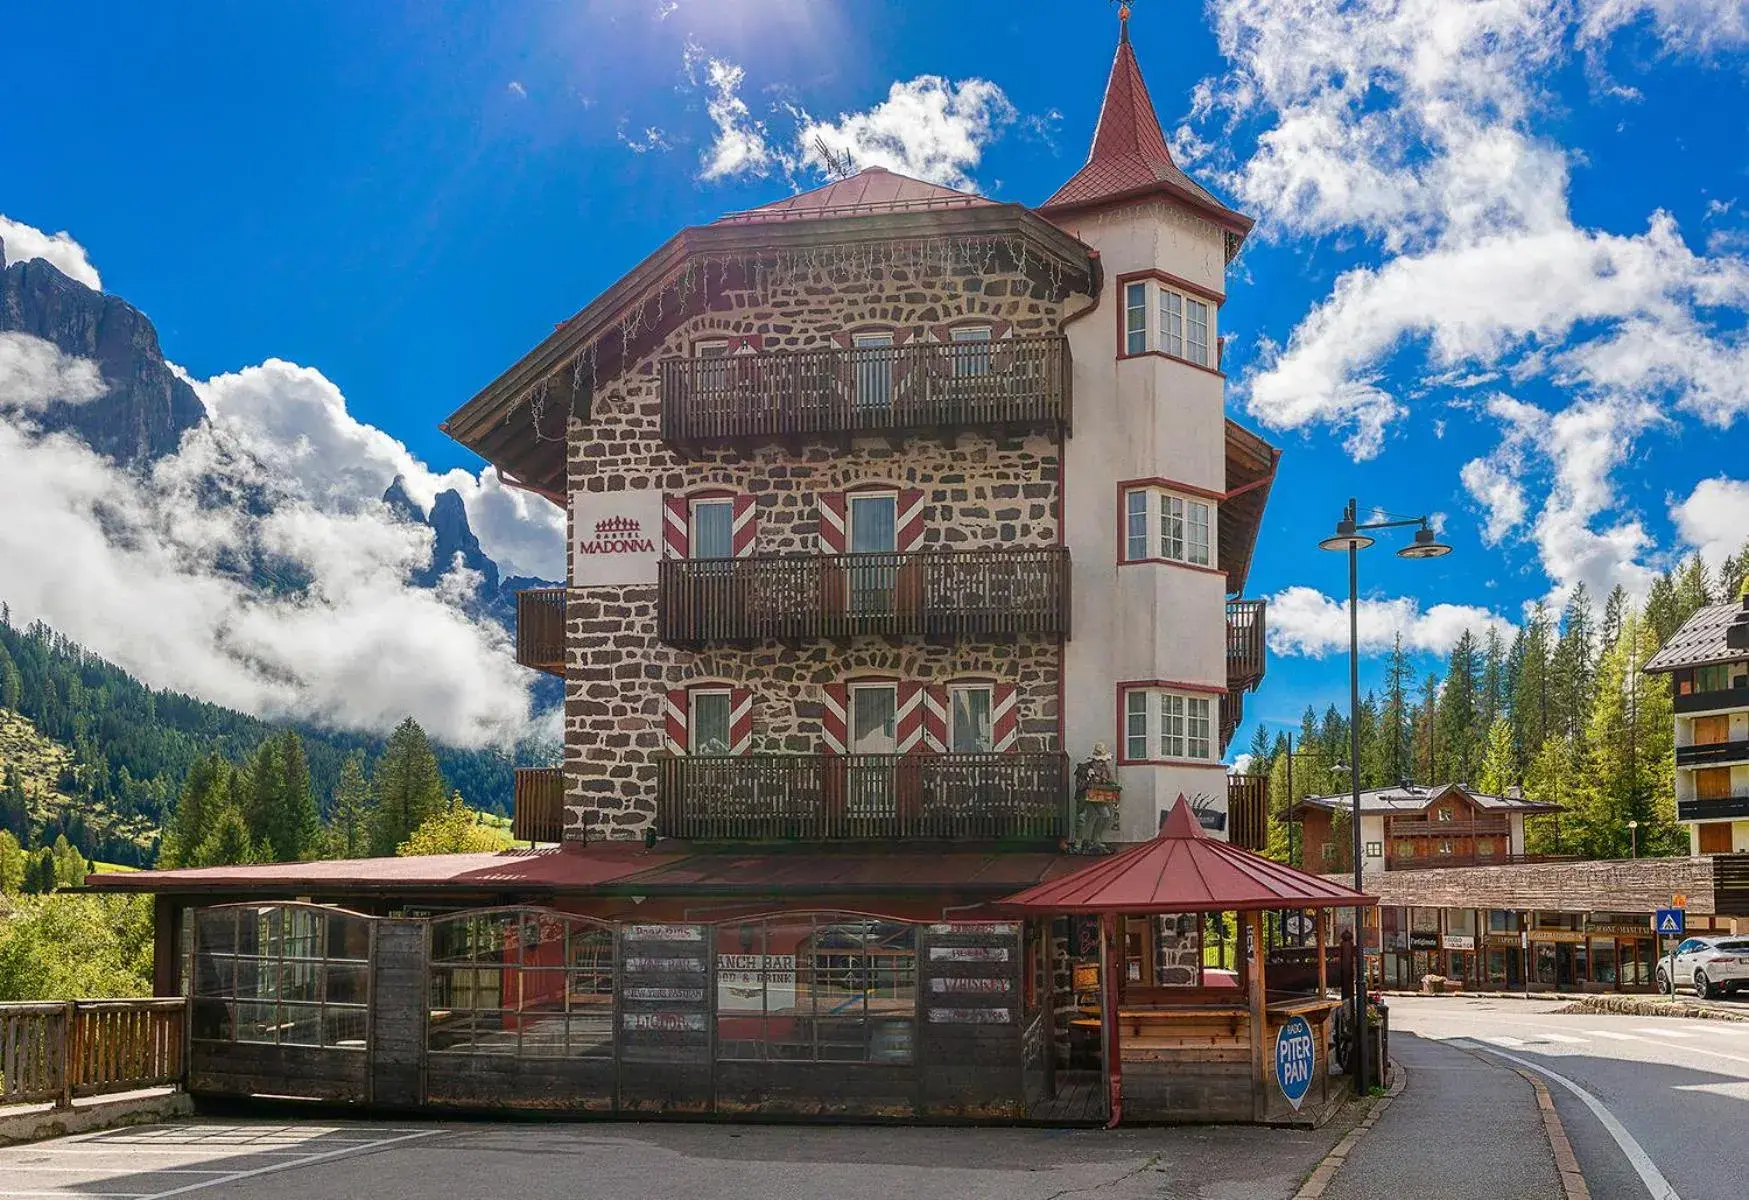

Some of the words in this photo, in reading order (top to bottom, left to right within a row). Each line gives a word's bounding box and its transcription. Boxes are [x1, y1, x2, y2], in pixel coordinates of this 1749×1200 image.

[595, 532, 641, 540] CASTEL
[580, 539, 655, 554] MADONNA
[716, 955, 756, 969] ANCH
[763, 956, 793, 969] BAR
[742, 973, 749, 983] &
[756, 973, 793, 984] DRINK
[1280, 1036, 1311, 1063] PITER
[1284, 1061, 1308, 1085] PAN
